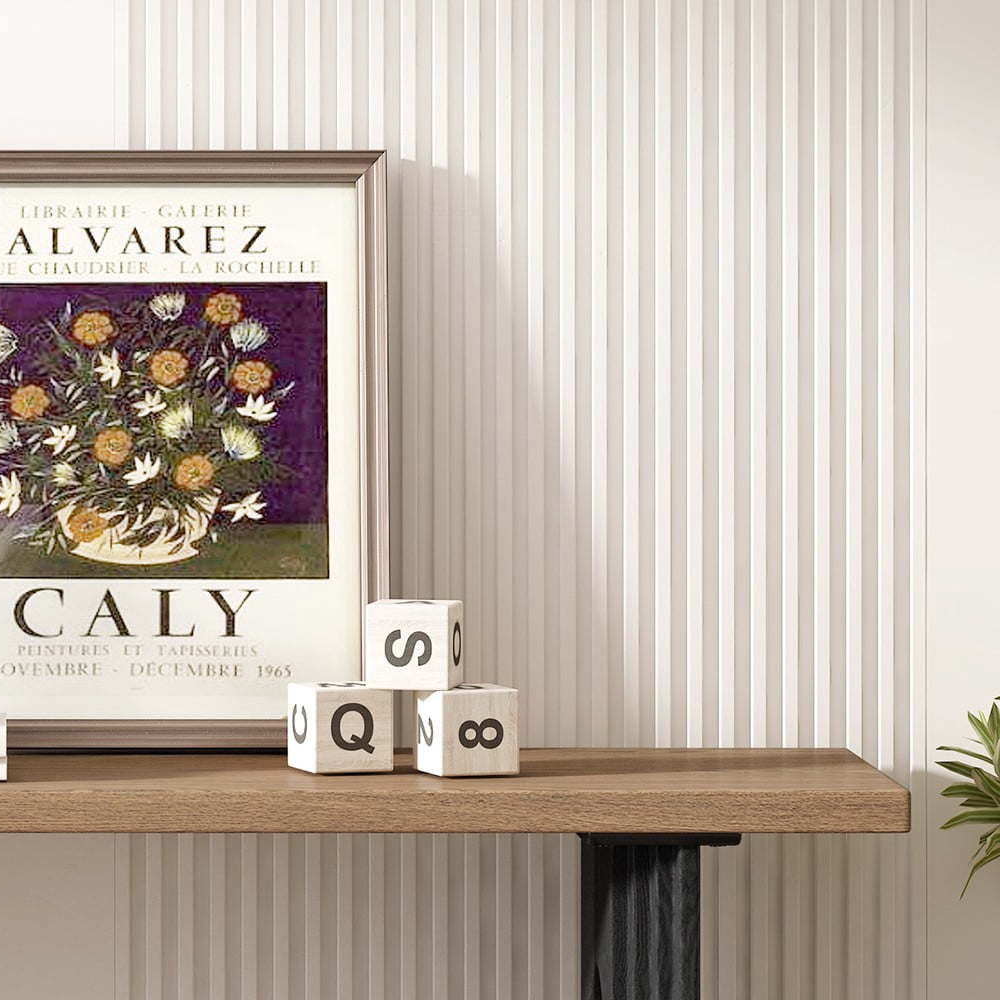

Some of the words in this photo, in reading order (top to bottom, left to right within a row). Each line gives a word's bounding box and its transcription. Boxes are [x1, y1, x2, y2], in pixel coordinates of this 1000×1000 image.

[20, 205, 132, 219] LIBRAIRIE
[157, 204, 252, 218] GALERIE
[6, 225, 268, 256] ALVAREZ
[27, 261, 151, 275] CHAUDRIER
[180, 261, 202, 275] LA
[215, 261, 321, 275] ROCHELLE
[13, 587, 260, 639] CALY
[17, 644, 110, 657] PEINTURES
[123, 644, 144, 657] ET
[158, 644, 258, 657] TAPISSERIES
[384, 629, 433, 668] S
[130, 660, 244, 678] DÉCEMBRE
[256, 664, 292, 678] 1965
[292, 703, 308, 745] C
[331, 702, 376, 755] Q
[417, 713, 434, 747] 2
[458, 718, 504, 750] 8
